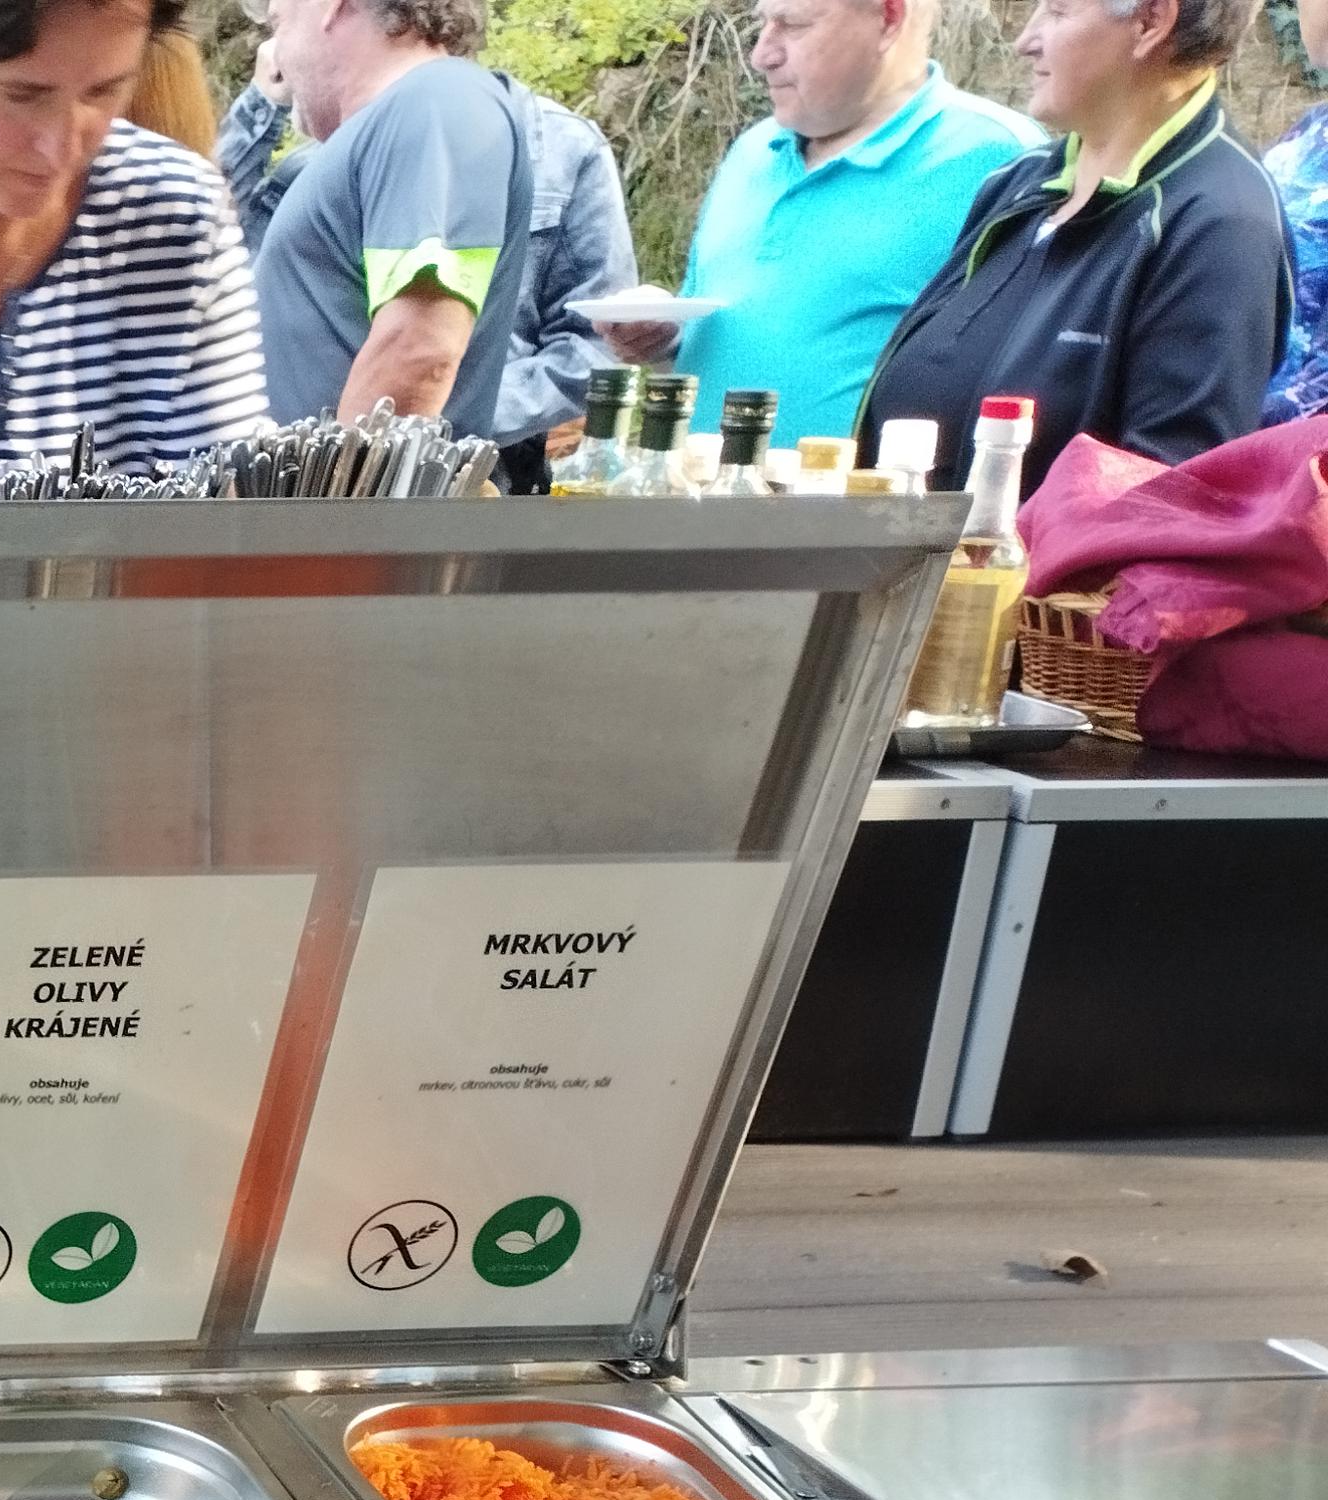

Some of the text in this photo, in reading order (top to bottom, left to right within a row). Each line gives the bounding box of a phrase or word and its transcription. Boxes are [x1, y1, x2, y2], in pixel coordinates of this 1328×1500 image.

[30, 938, 146, 968] ZELENÉ
[483, 924, 637, 956] MRKVOVÝ
[499, 961, 597, 991] SALÁT
[33, 981, 128, 1003] OLIVY
[4, 1009, 141, 1039] KRÁJENÉ
[490, 1063, 549, 1076] obsahuje
[29, 1078, 90, 1090] obsahuje
[460, 1079, 519, 1090] citronovou
